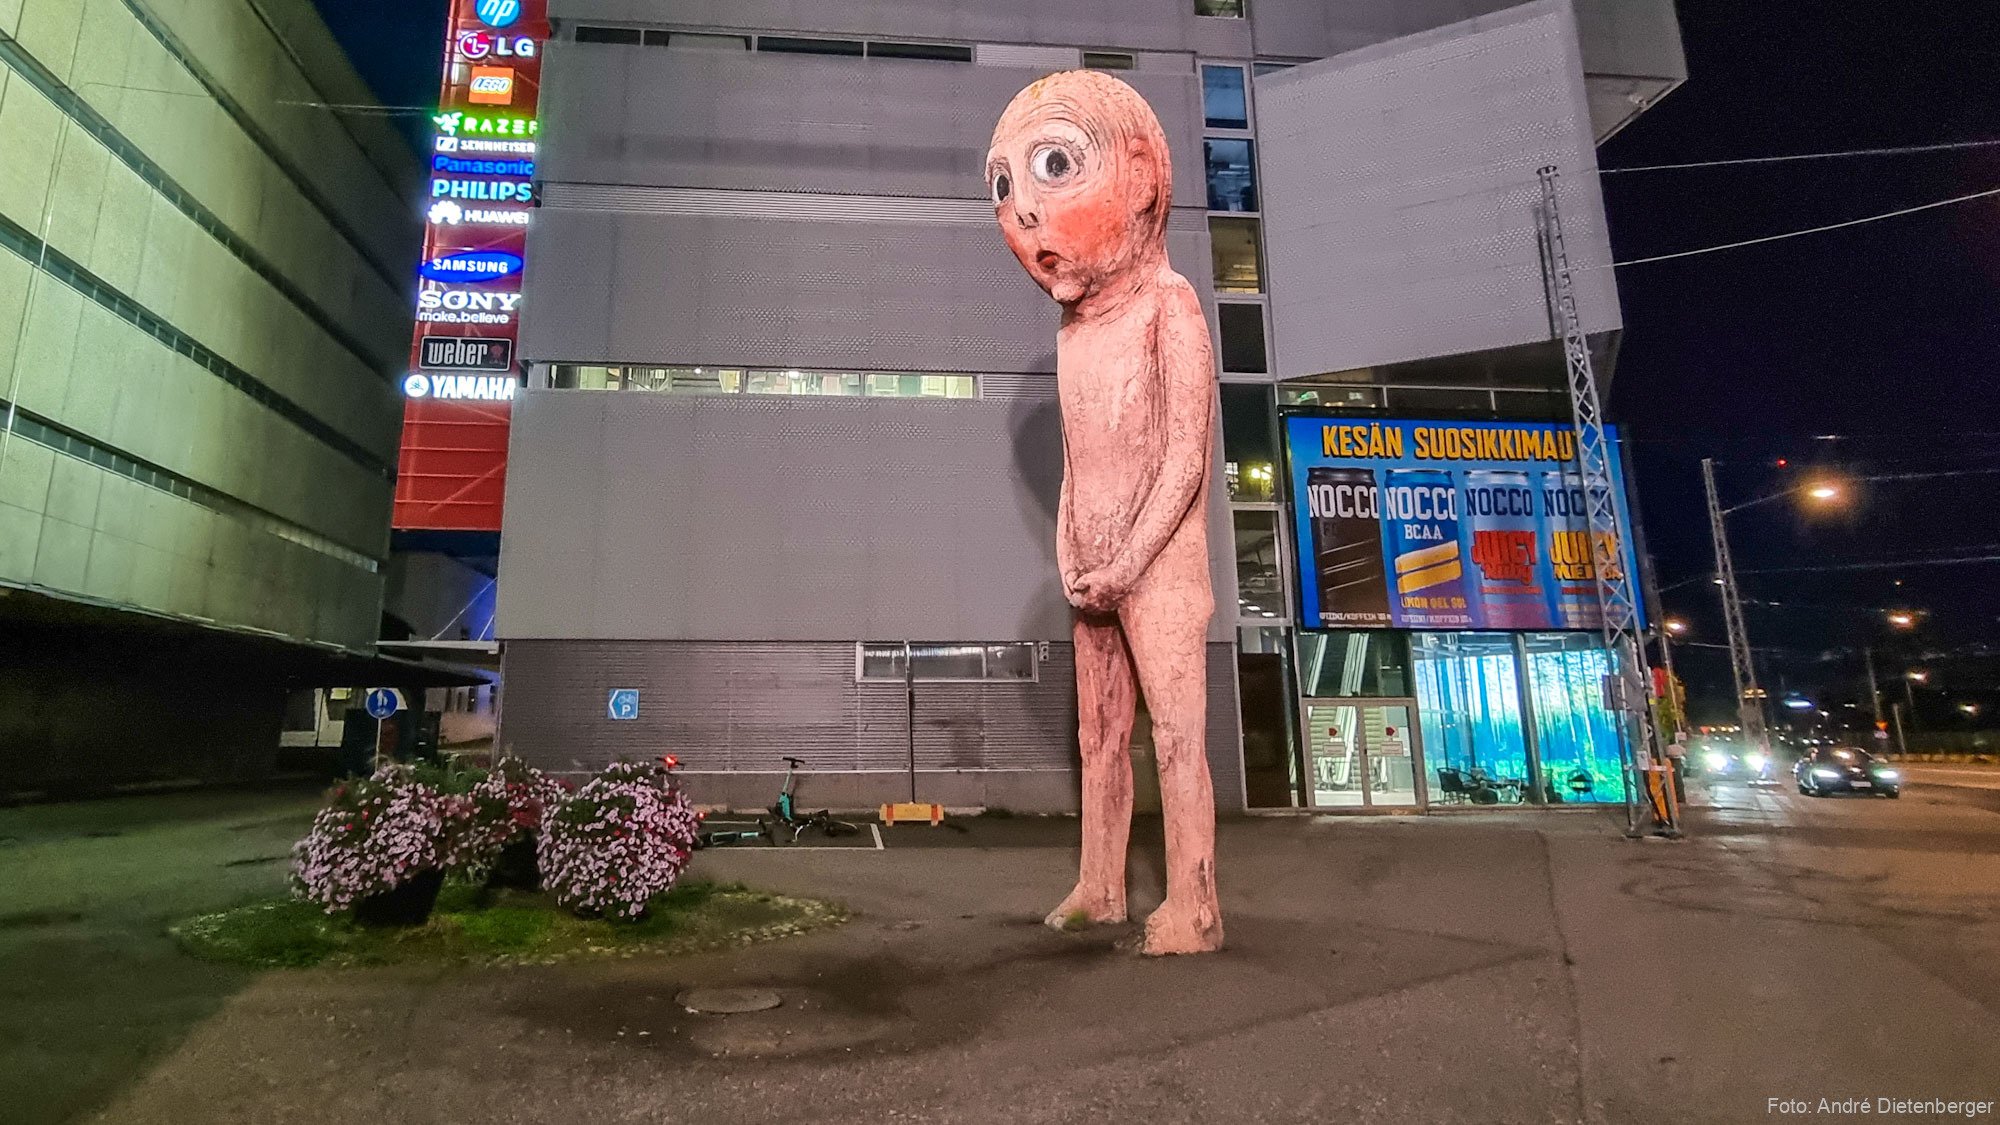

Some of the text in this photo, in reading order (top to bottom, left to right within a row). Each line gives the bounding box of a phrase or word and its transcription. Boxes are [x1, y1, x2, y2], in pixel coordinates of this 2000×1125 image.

[481, 0, 516, 26] hp
[497, 38, 535, 57] LG
[476, 77, 511, 92] LEGO
[460, 140, 536, 153] SENNHEISER
[435, 155, 534, 175] Panasonic
[432, 179, 532, 202] PHILIPS
[464, 210, 529, 224] HUAWEI
[432, 258, 508, 274] SAMSUNG
[419, 290, 522, 311] SONY
[418, 311, 510, 324] make.believe
[427, 337, 488, 366] weber
[431, 375, 516, 400] YAMAHA
[1322, 421, 1577, 461] KESÄN SUOSIKKIMAU
[1465, 488, 1533, 516] NOCCO
[1404, 523, 1444, 540] BCAA
[622, 704, 631, 716] P
